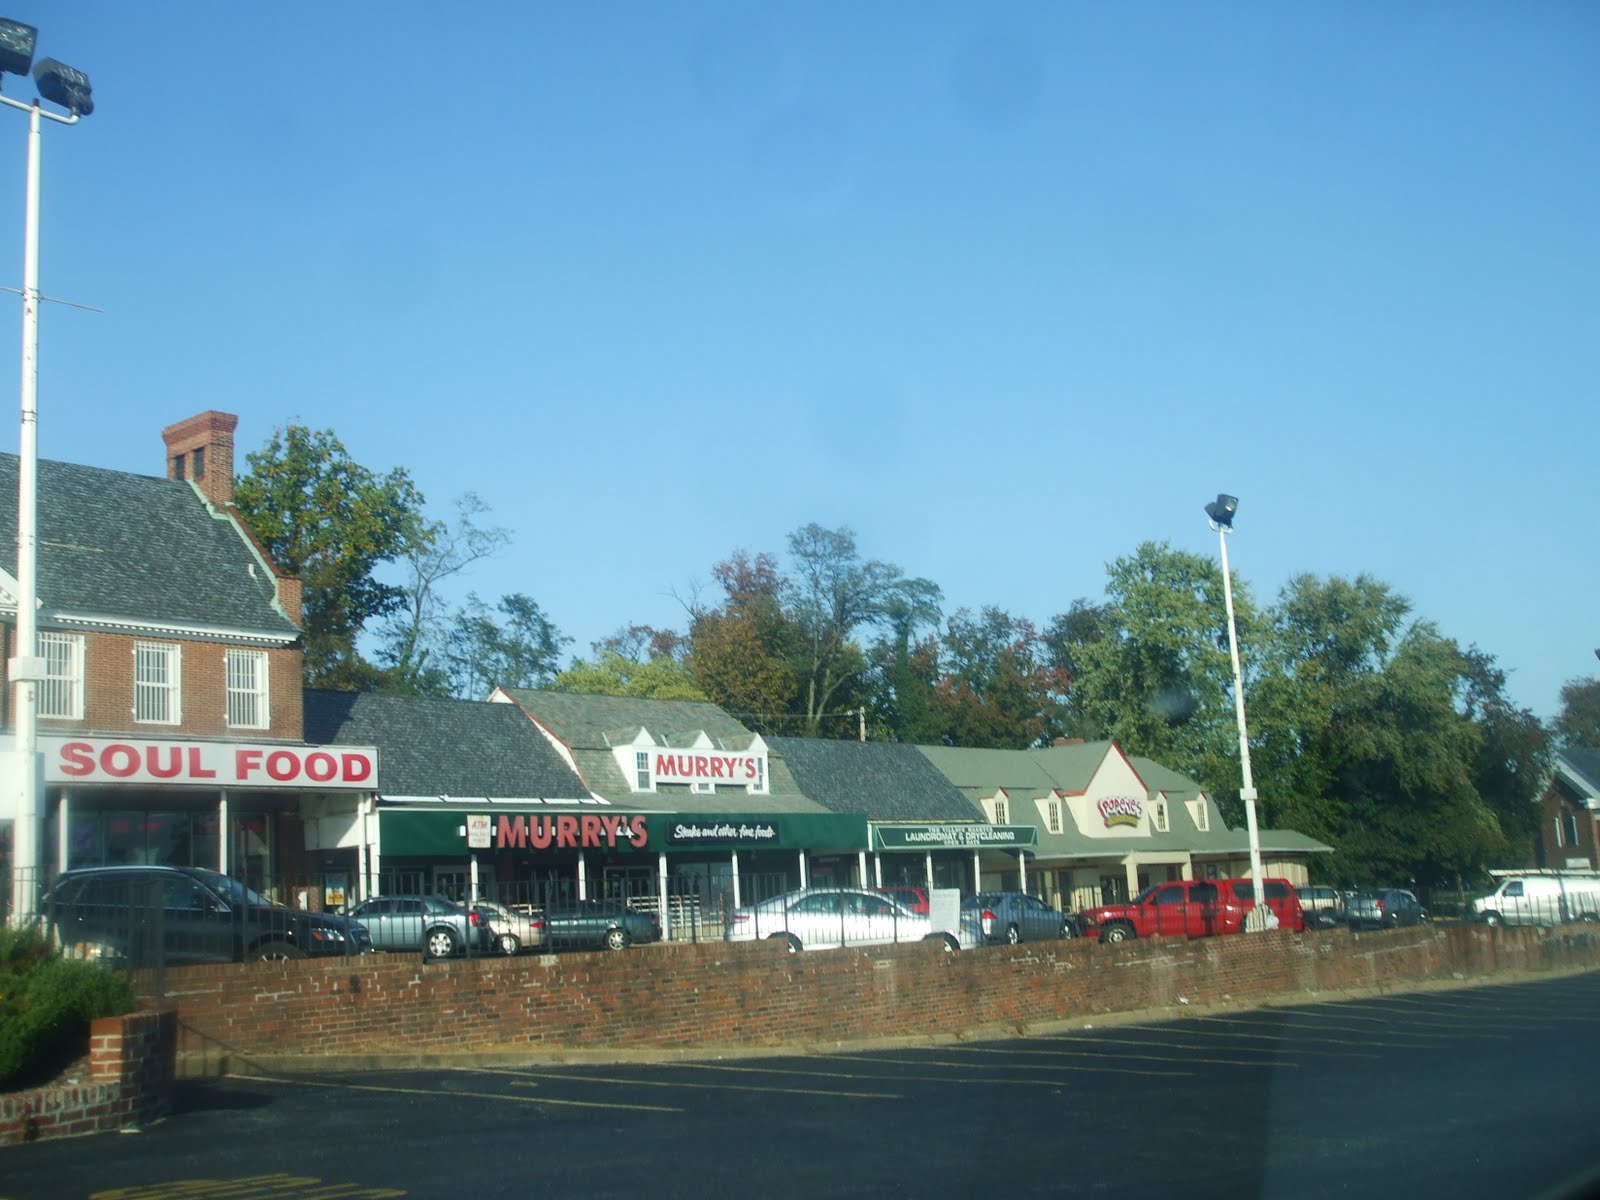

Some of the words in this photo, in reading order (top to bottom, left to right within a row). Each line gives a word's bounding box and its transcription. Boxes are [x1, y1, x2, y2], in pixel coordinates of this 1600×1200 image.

[59, 742, 216, 778] SOUL
[235, 749, 371, 782] FOOD
[656, 754, 756, 779] MURRY'S
[472, 820, 488, 830] ATM
[497, 814, 648, 849] MURRY'S
[905, 832, 958, 842] LAUNDROMAT
[958, 832, 964, 841] &
[965, 831, 1015, 841] DRYCLEANING
